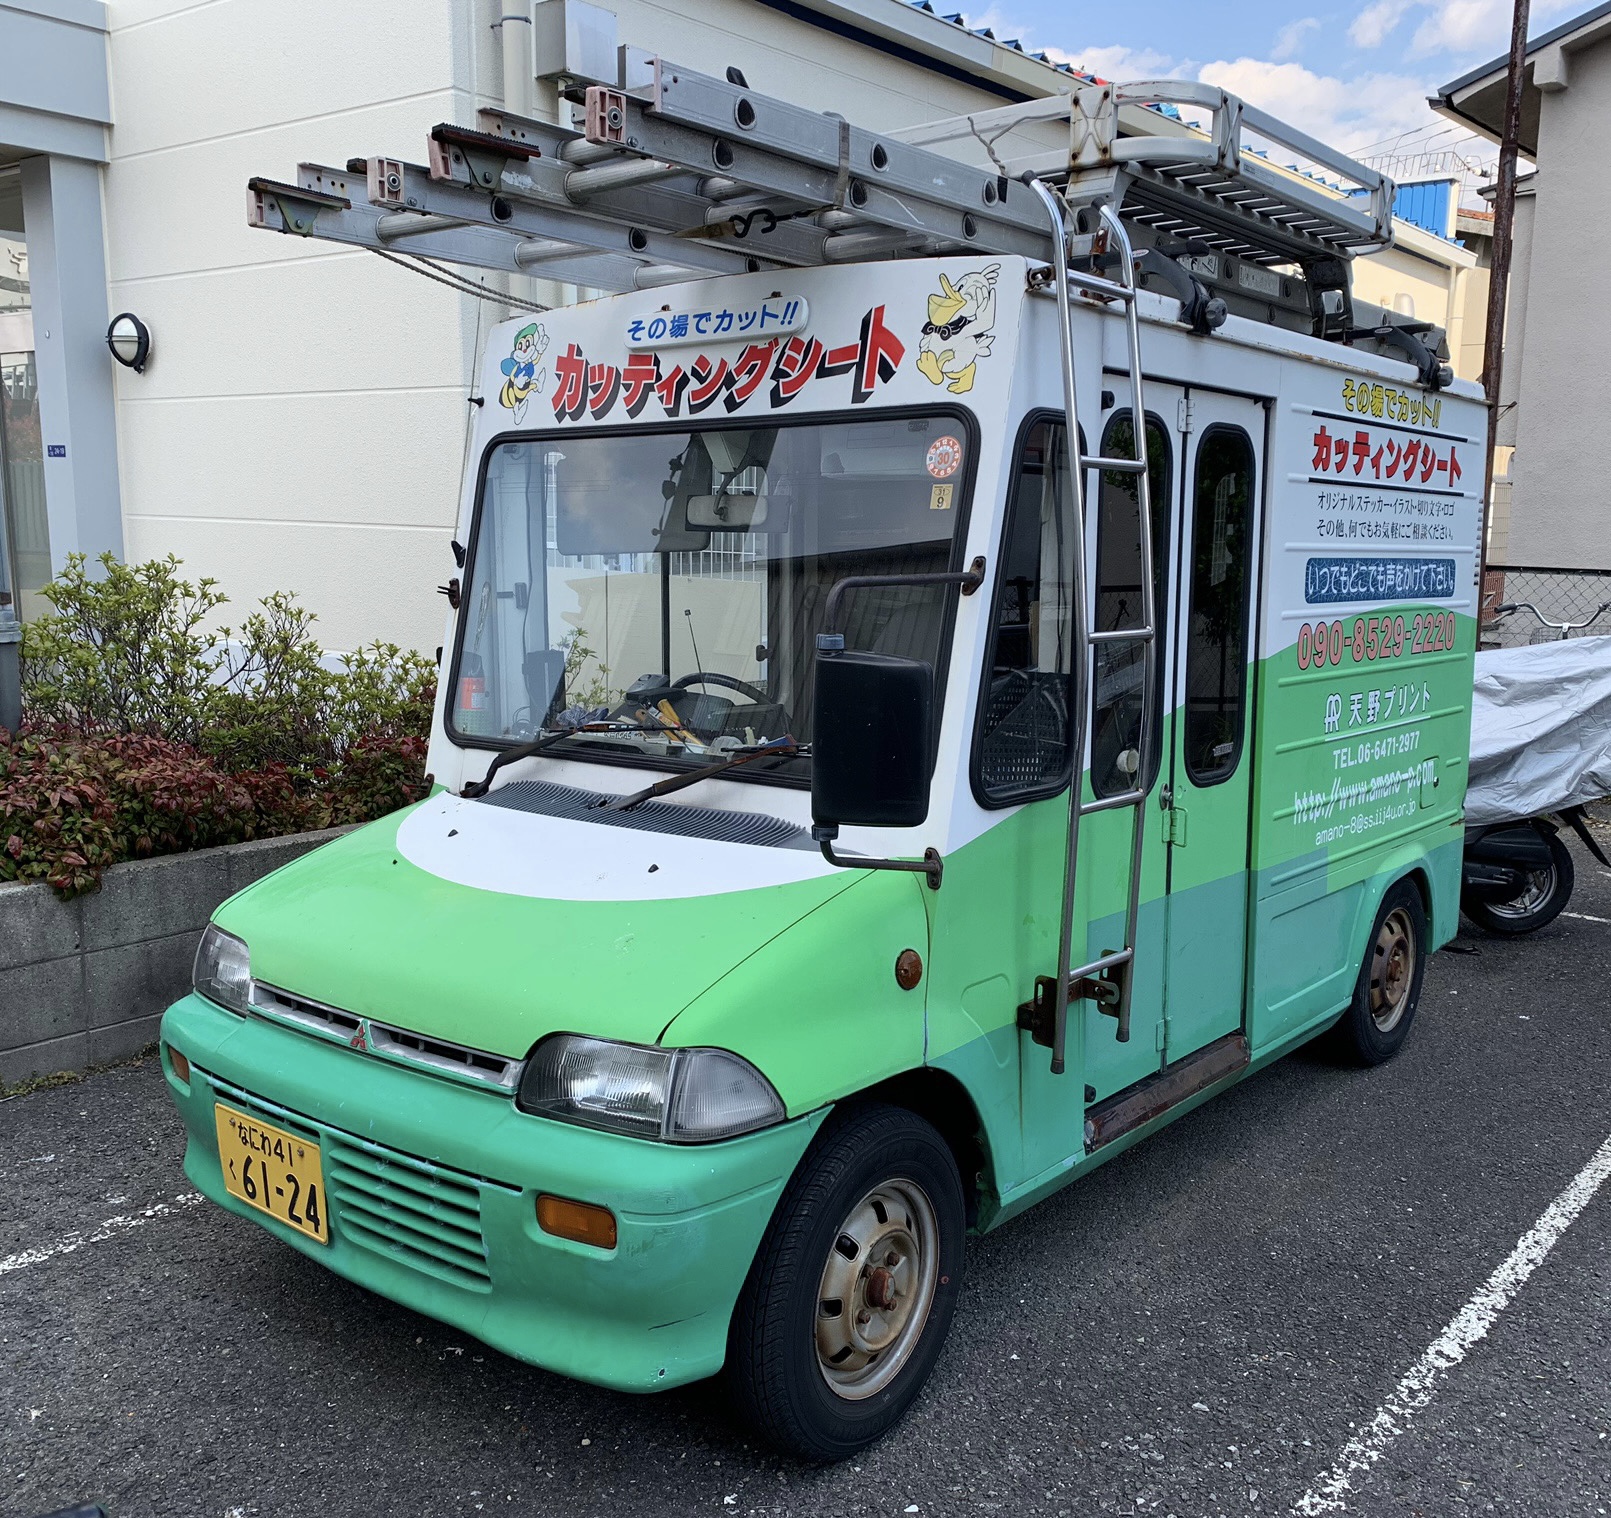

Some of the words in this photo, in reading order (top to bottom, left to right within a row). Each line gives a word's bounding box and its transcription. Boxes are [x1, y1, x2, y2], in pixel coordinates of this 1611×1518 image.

[627, 301, 799, 341] その場でカット!!
[551, 304, 905, 424] カッティングシート
[1341, 378, 1442, 428] その場でカット!!
[937, 452, 950, 465] 30
[1311, 425, 1462, 487] カッティングシート
[937, 496, 945, 508] 9
[1297, 611, 1456, 670] 090-8529-2220
[1348, 681, 1431, 727] 天野プリント
[242, 1155, 321, 1234] 61-24
